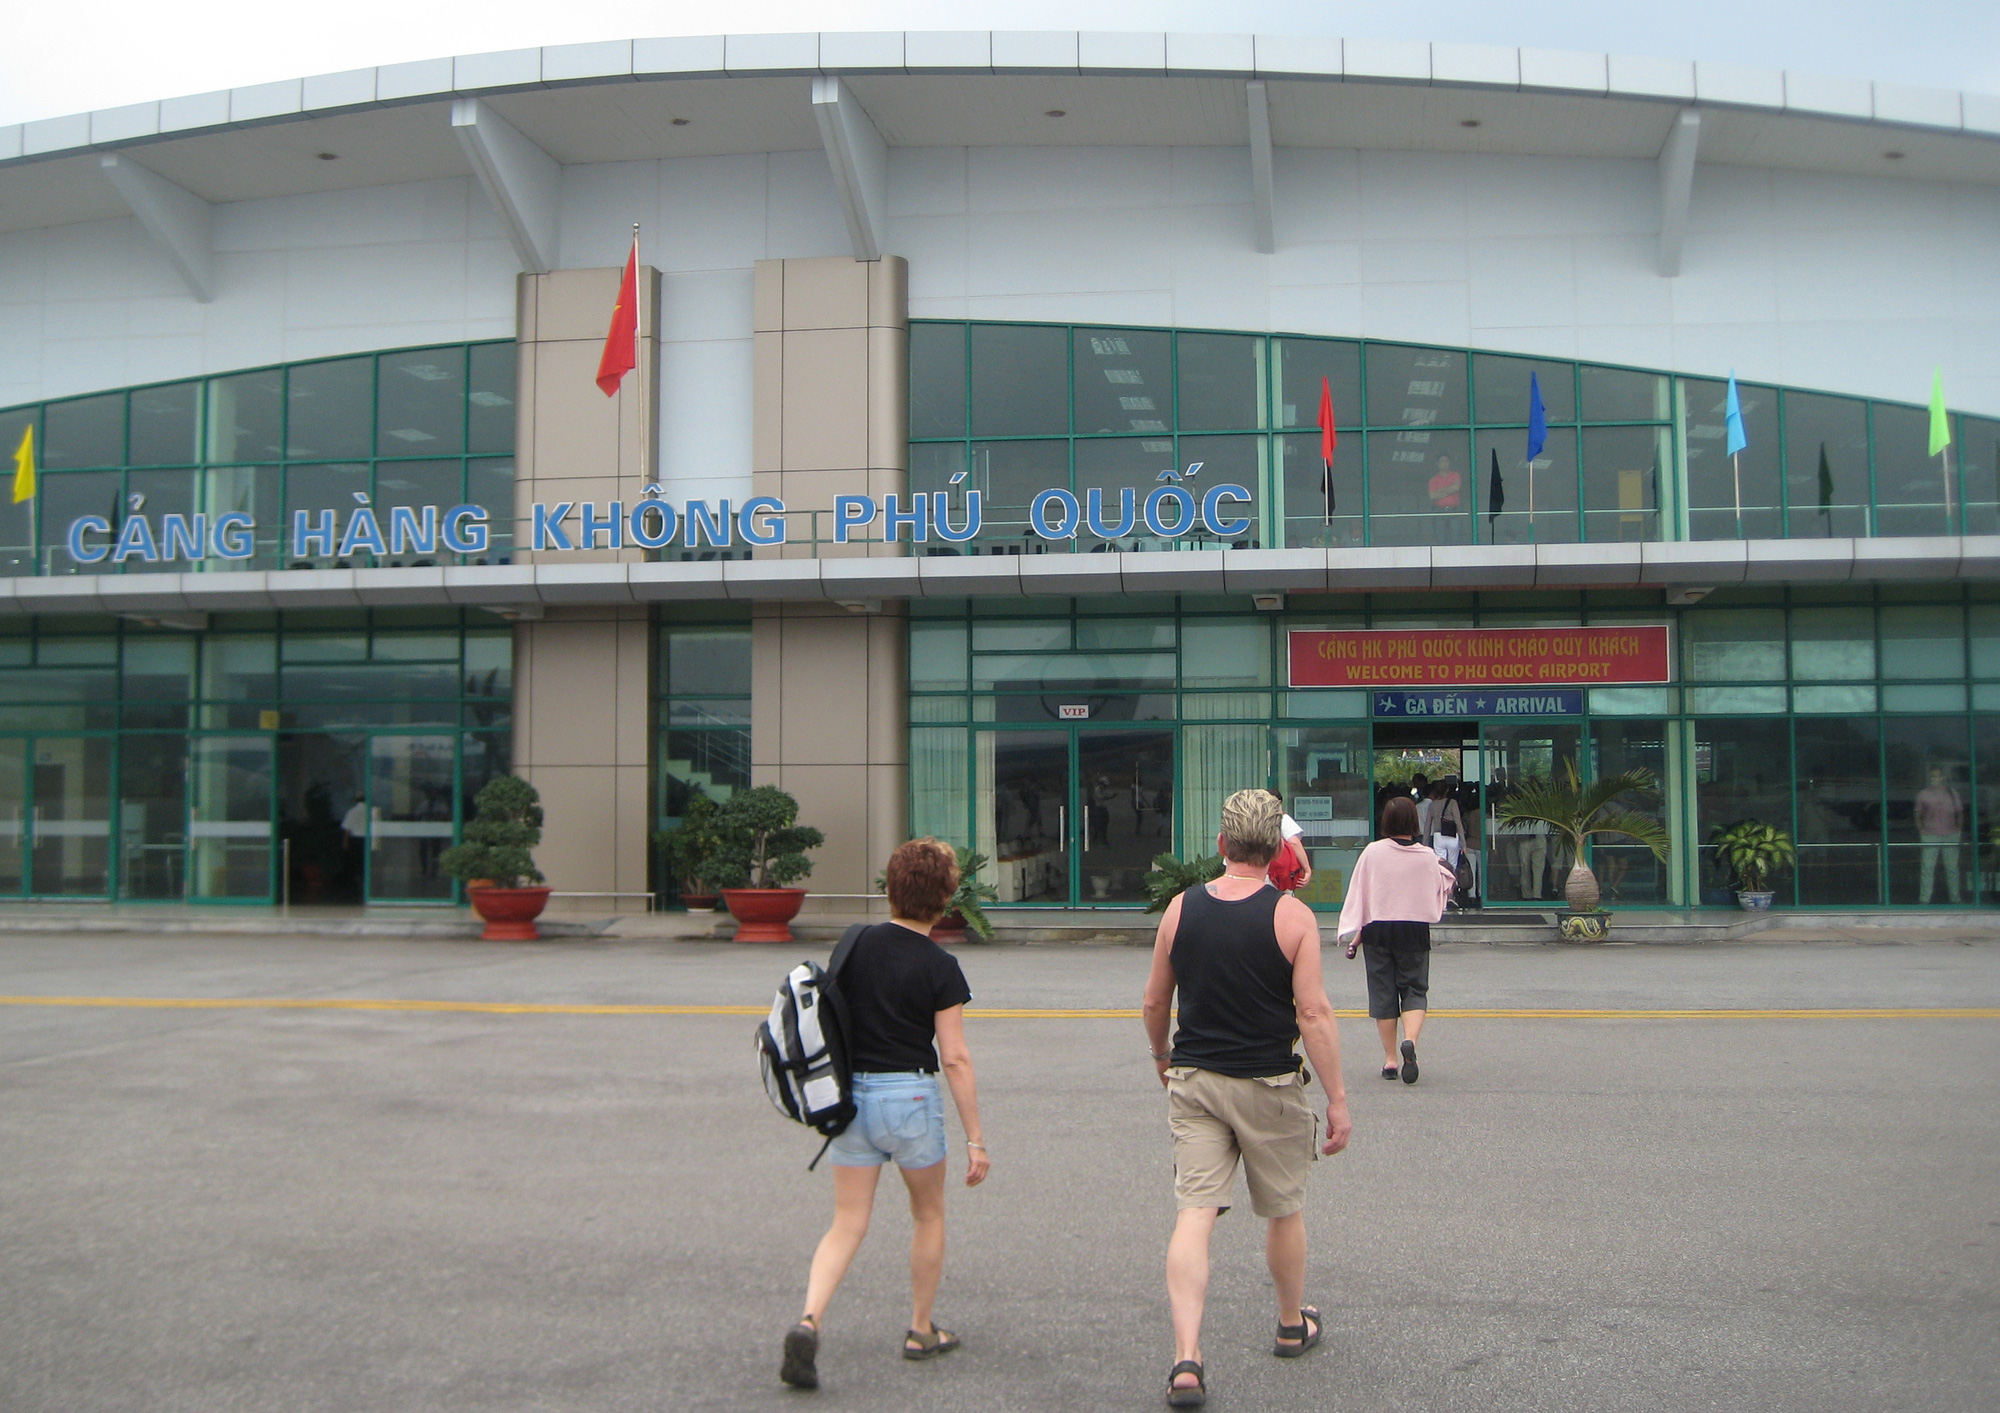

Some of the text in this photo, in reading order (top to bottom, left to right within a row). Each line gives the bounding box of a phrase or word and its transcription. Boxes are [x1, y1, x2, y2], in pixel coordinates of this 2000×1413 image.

[68, 461, 1252, 563] CẢNG HÀNG KHÔNG PHÚ QUỐC
[1362, 639, 1383, 660] HK
[1388, 635, 1417, 660] PHÚ
[1422, 634, 1462, 658] QUỐC
[1468, 634, 1504, 658] KÍNH
[1508, 633, 1548, 658] CHÀO
[1589, 632, 1639, 657] KHÁCH
[1346, 662, 1611, 679] WELCOME TO PHU QUOC AIRPORT
[1062, 708, 1086, 716] VIP
[1405, 693, 1566, 714] GA ĐẾN ARRIVAL
